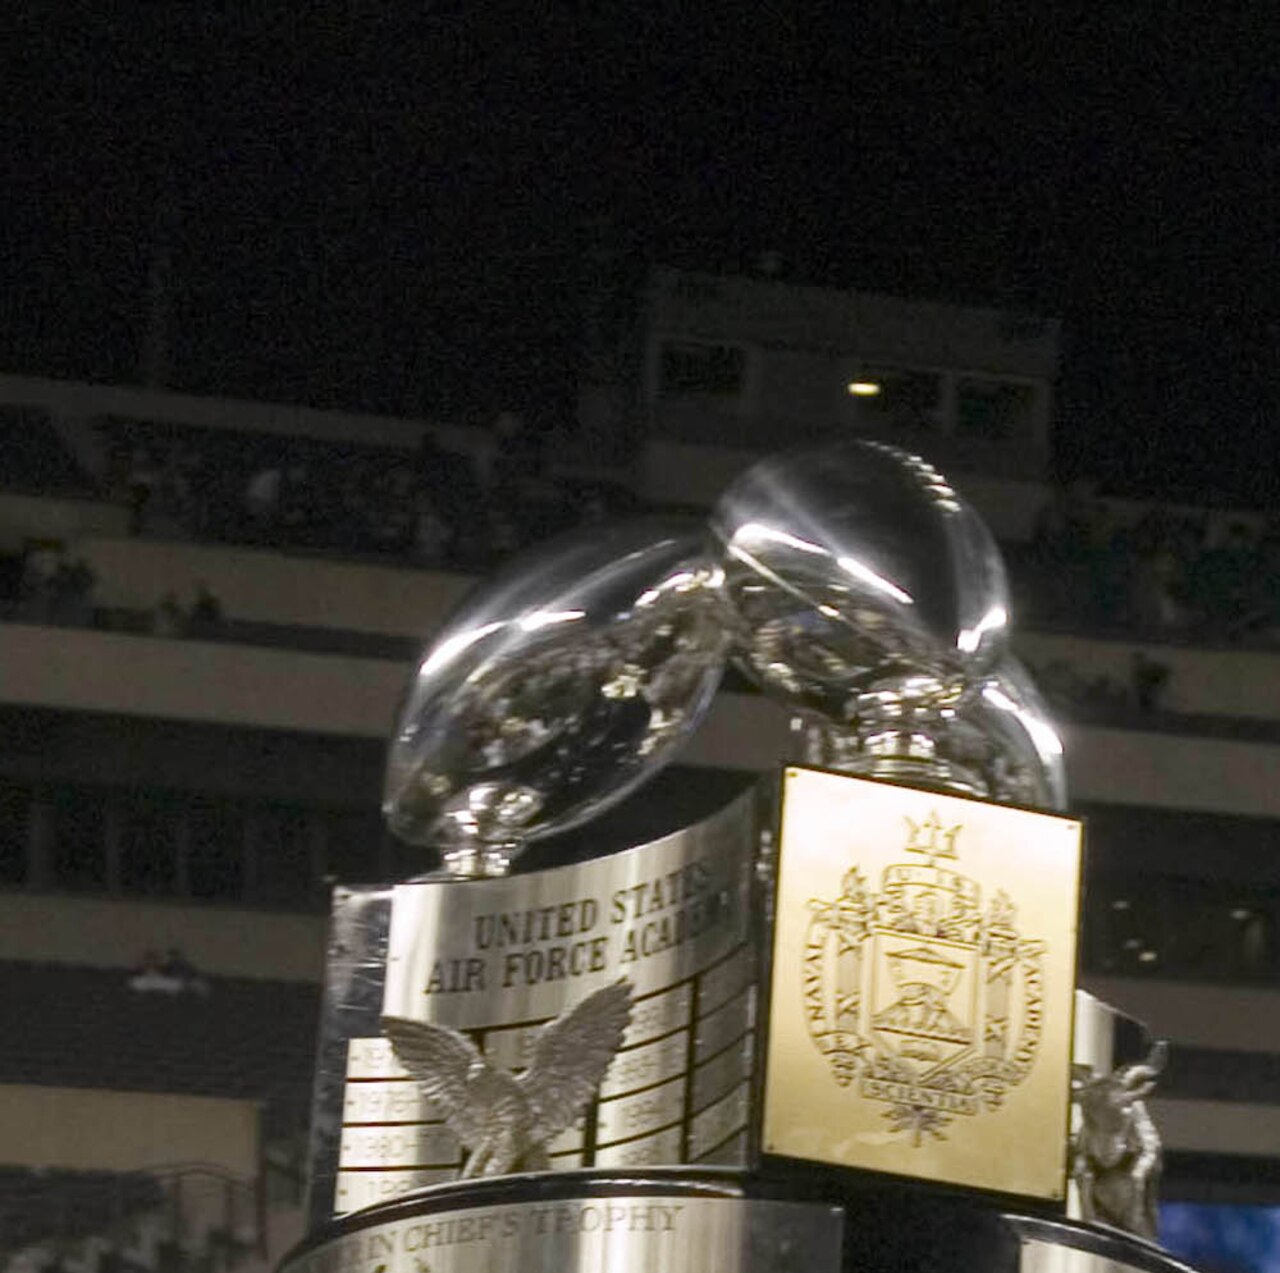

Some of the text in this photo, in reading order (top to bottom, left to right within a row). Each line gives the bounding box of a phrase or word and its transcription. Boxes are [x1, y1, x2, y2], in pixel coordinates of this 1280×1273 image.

[474, 898, 598, 950] UNITED
[424, 957, 487, 994] AIR
[502, 936, 608, 988] FORCE
[403, 1211, 519, 1252] CHIEF'S
[529, 1204, 685, 1236] TROPHY
